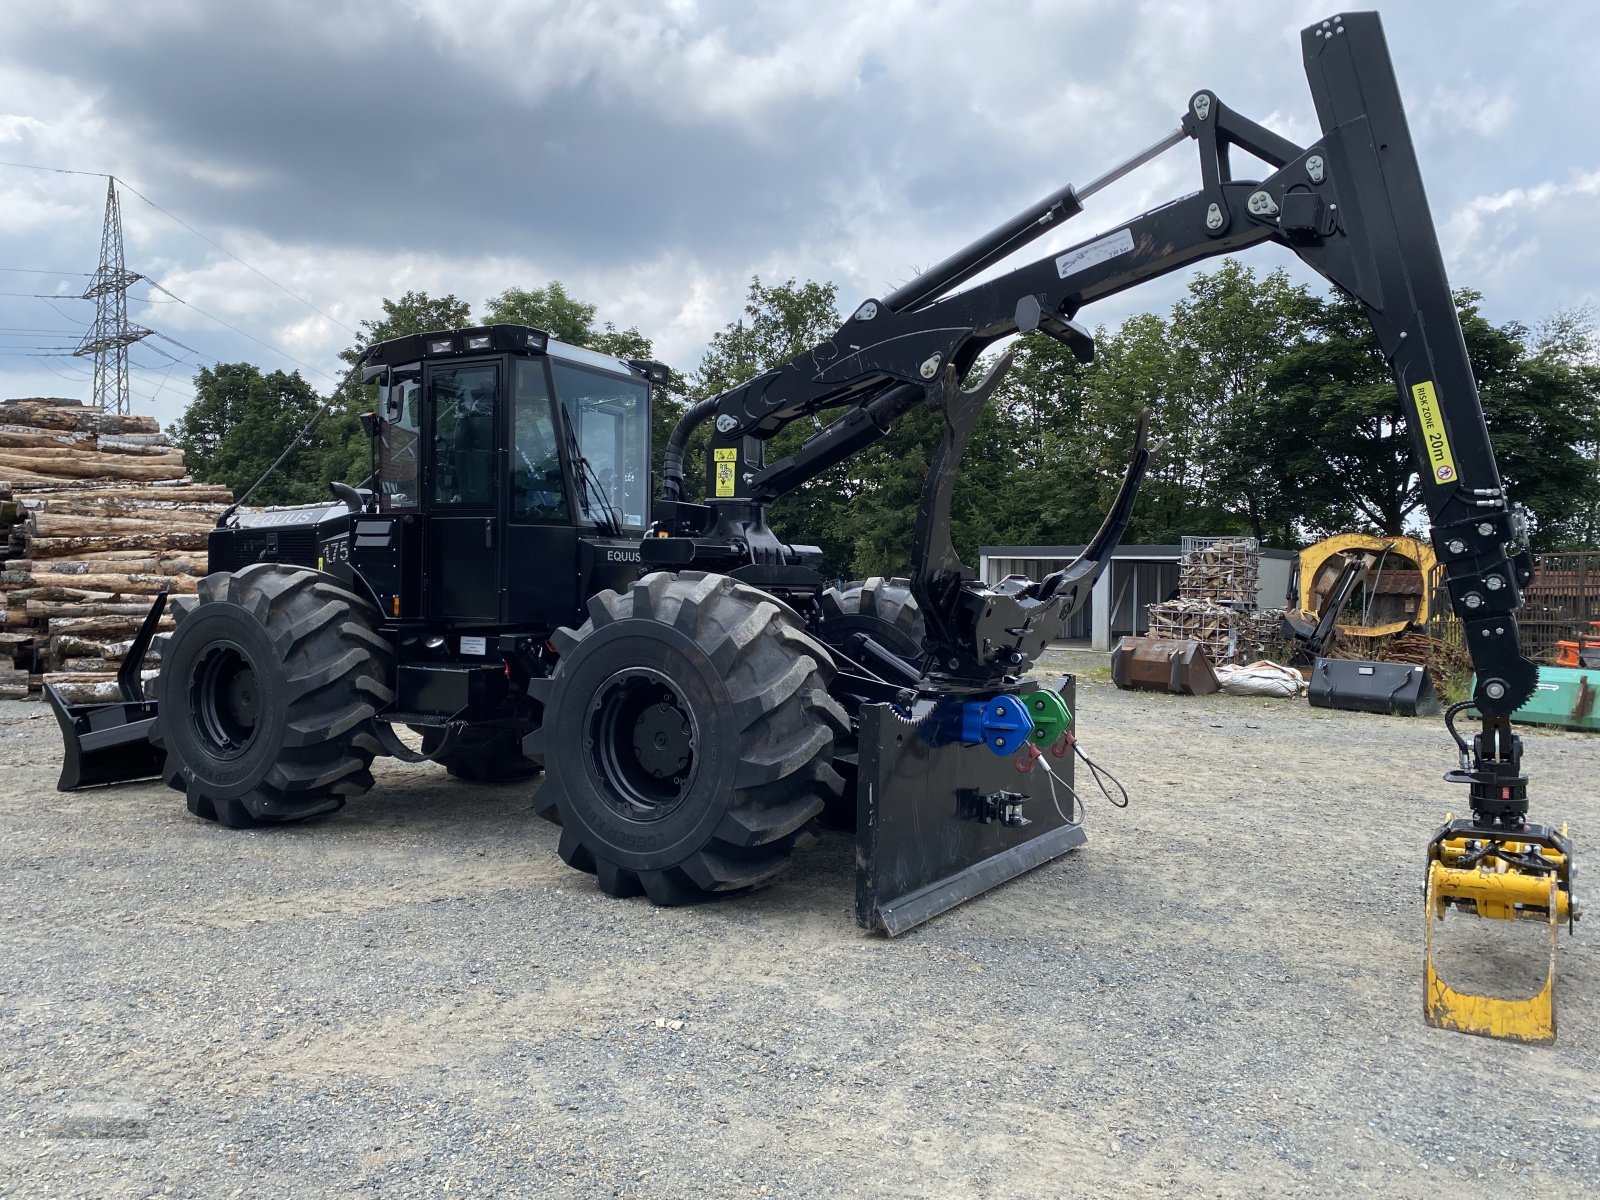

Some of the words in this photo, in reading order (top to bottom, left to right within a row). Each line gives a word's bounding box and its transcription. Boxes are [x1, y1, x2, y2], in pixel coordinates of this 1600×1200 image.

[1417, 387, 1429, 406] RISK
[1422, 407, 1435, 430] ZONE
[1429, 432, 1444, 461] 20m
[251, 511, 313, 526] EQUUS
[322, 540, 349, 564] 175
[607, 550, 641, 562] EQUUS
